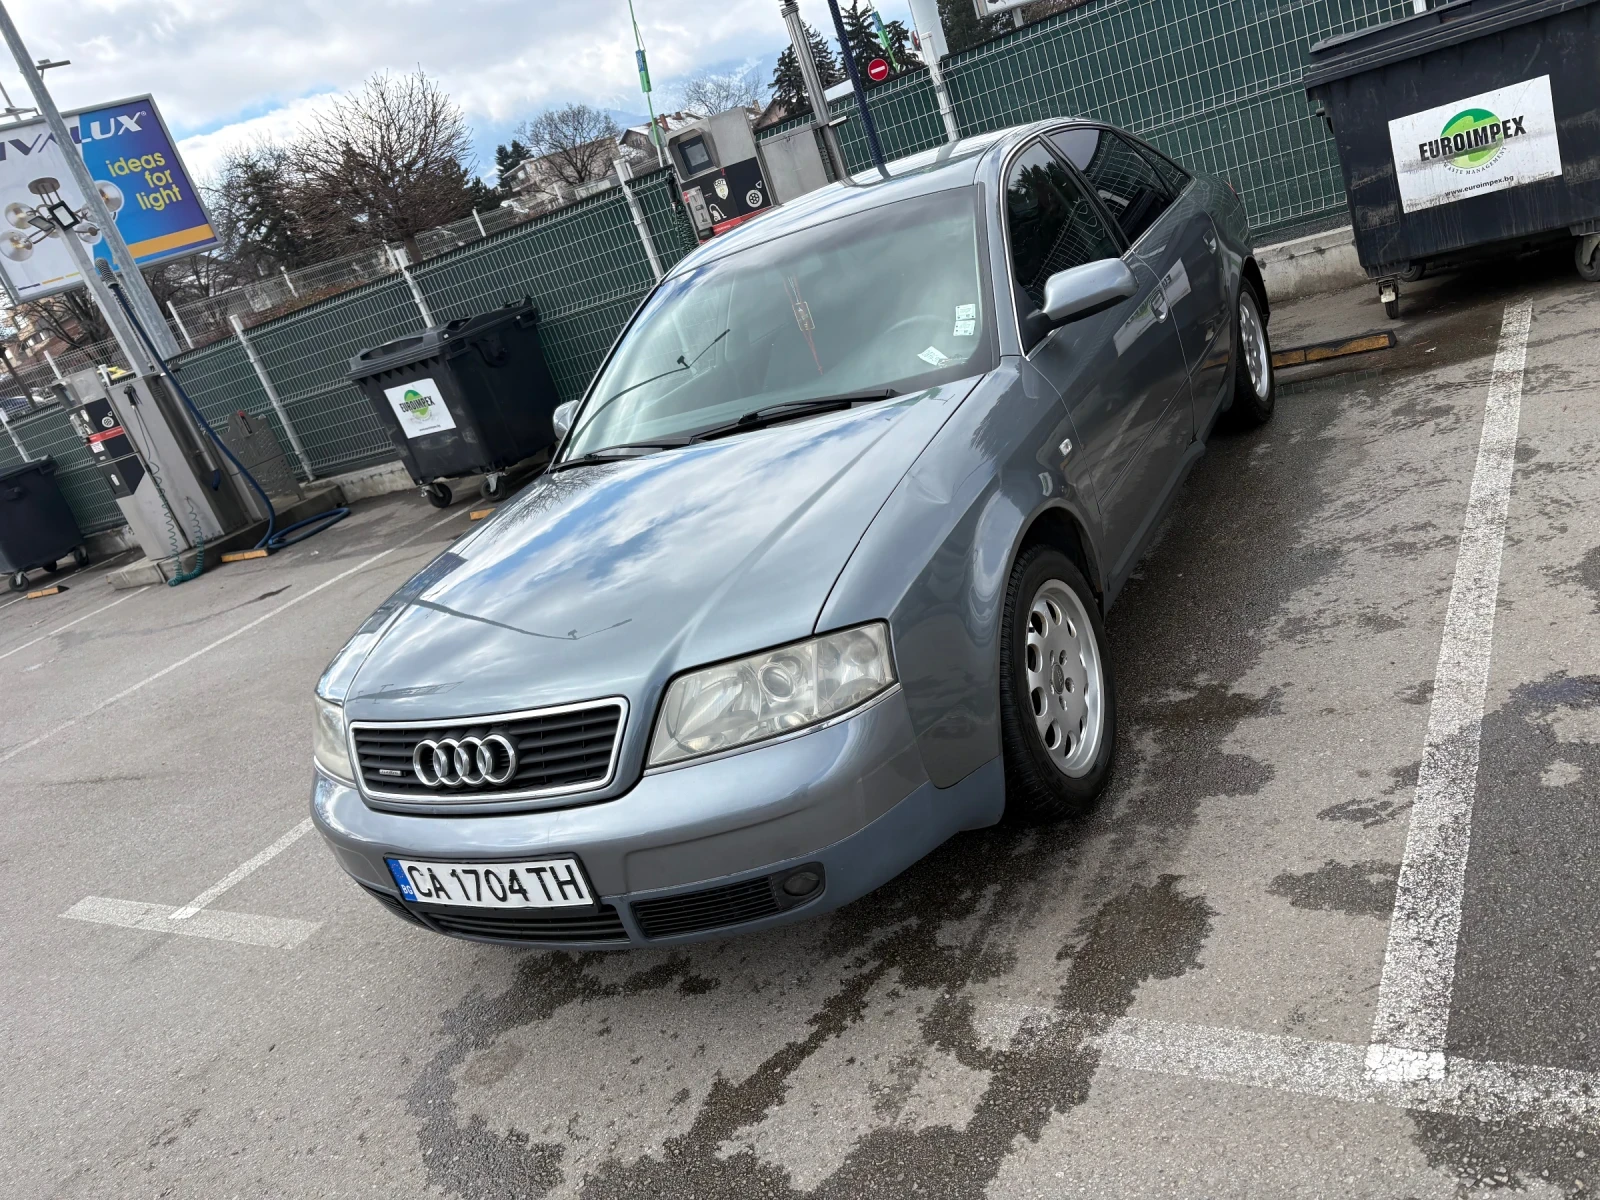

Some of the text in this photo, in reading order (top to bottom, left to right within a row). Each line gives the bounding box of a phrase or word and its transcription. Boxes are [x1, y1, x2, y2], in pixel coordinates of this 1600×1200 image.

[1419, 116, 1526, 161] EUROIMPEX
[105, 152, 166, 177] ideas
[1443, 147, 1507, 175] WASTE MANAGEMENT
[144, 169, 173, 188] for
[1445, 175, 1514, 197] www.euroimpex.bg
[136, 184, 182, 211] light
[399, 396, 435, 413] EUROIMPEX
[401, 884, 413, 895] BG
[407, 865, 585, 902] CA 1704 TH
